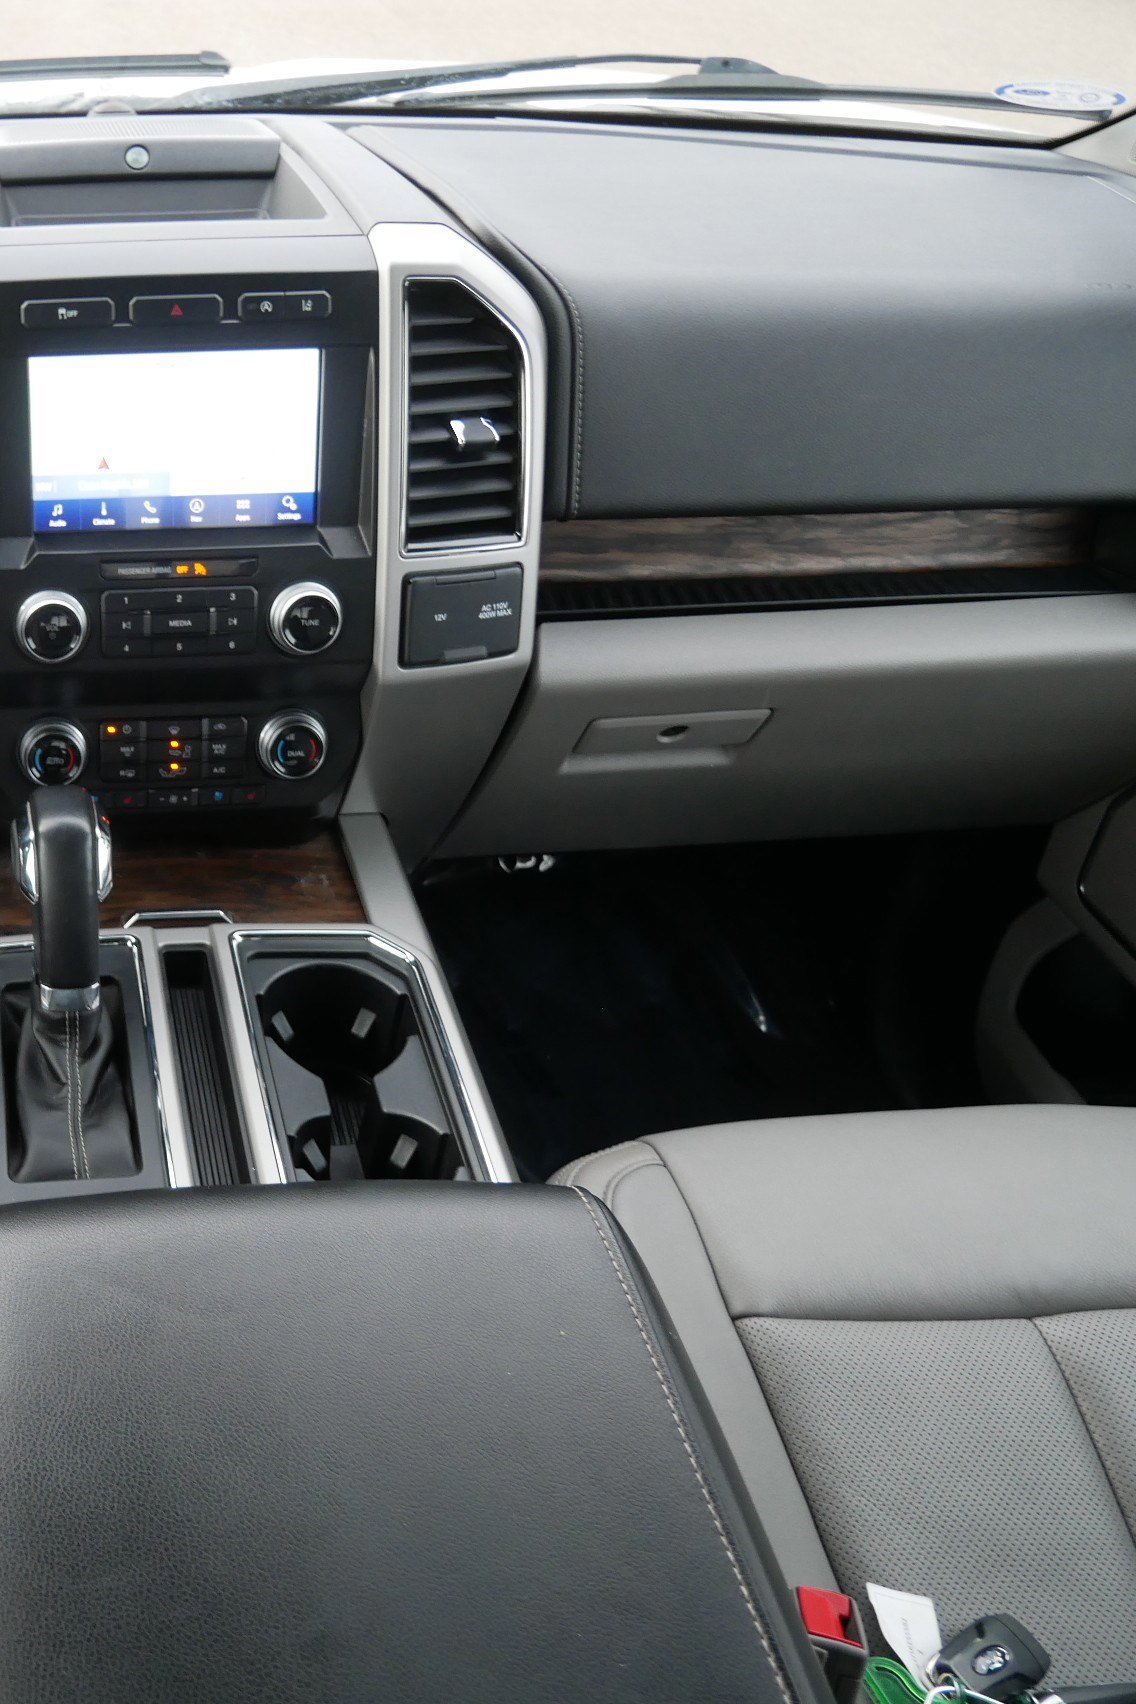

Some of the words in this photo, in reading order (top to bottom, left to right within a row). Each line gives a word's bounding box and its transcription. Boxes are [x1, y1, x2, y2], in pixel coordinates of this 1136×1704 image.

[176, 595, 183, 603] 2
[229, 592, 236, 601] 3
[497, 609, 512, 617] MAX
[434, 613, 447, 622] 12V
[169, 619, 192, 627] MEDIA
[301, 619, 320, 627] TUNE
[123, 644, 130, 652] 4
[176, 642, 183, 651] 5
[229, 641, 235, 650] 6
[287, 750, 306, 758] DUAL
